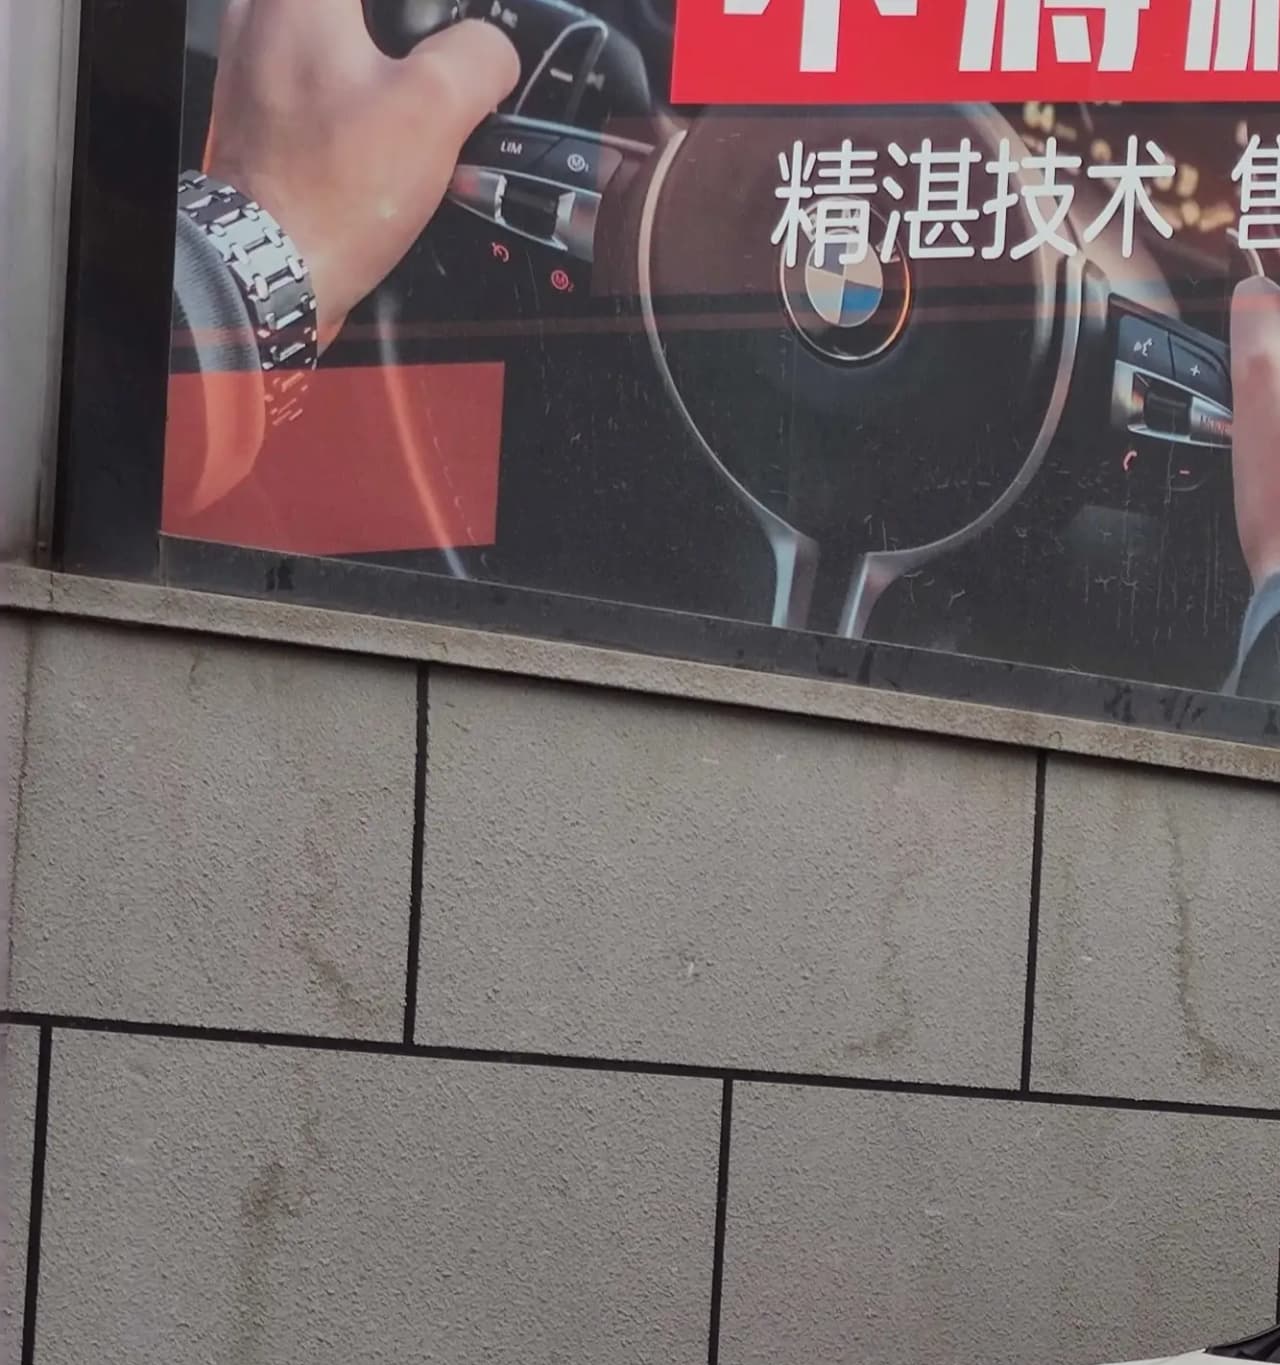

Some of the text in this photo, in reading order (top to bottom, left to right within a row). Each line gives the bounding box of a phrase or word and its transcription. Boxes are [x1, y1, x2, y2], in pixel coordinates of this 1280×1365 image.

[500, 140, 523, 155] LIM
[770, 134, 1177, 268] 精湛技术
